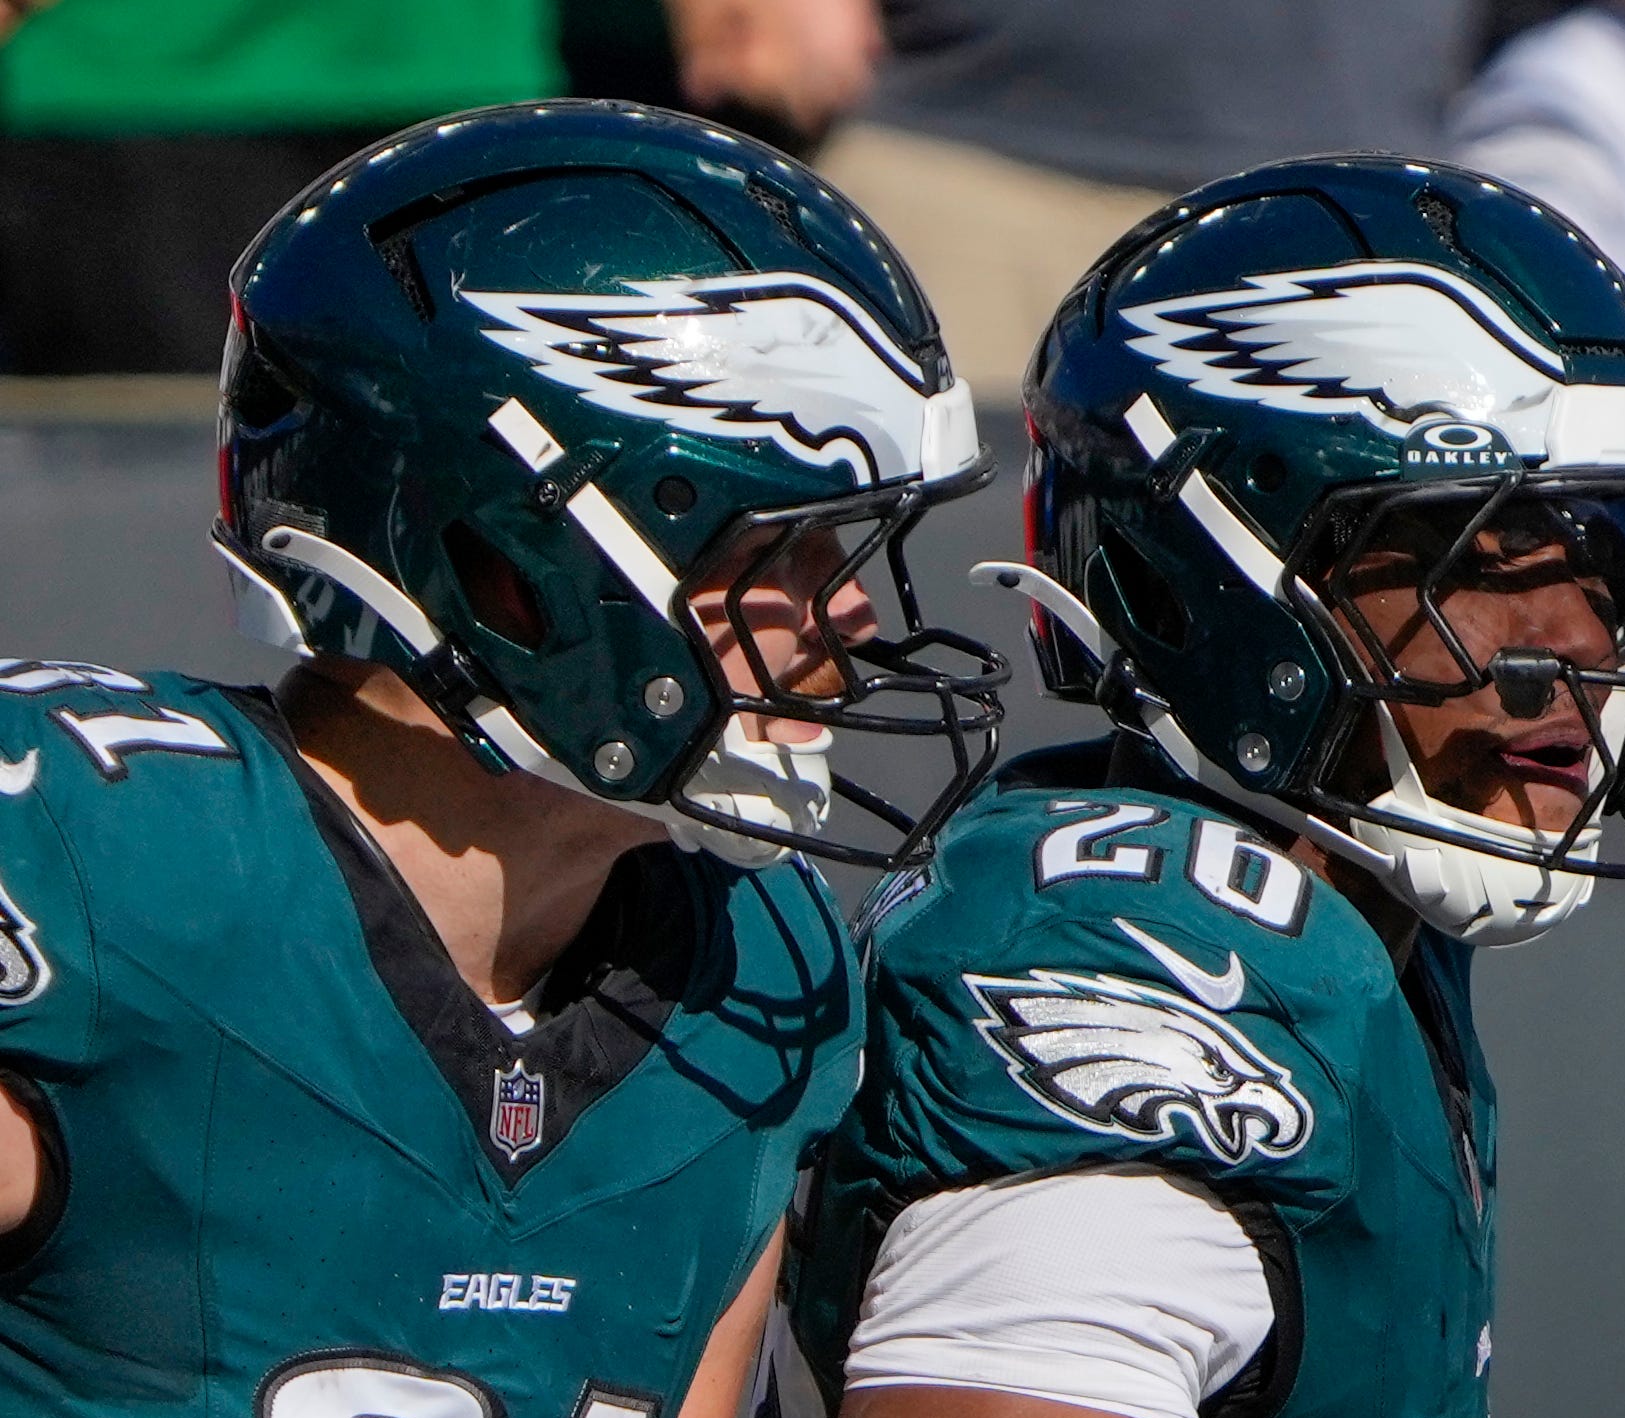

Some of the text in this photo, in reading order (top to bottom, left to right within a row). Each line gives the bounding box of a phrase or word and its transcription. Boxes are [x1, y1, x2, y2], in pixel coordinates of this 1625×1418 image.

[1407, 449, 1508, 465] OAKLEY
[499, 1104, 534, 1144] NFL
[439, 1273, 576, 1312] EAGLES
